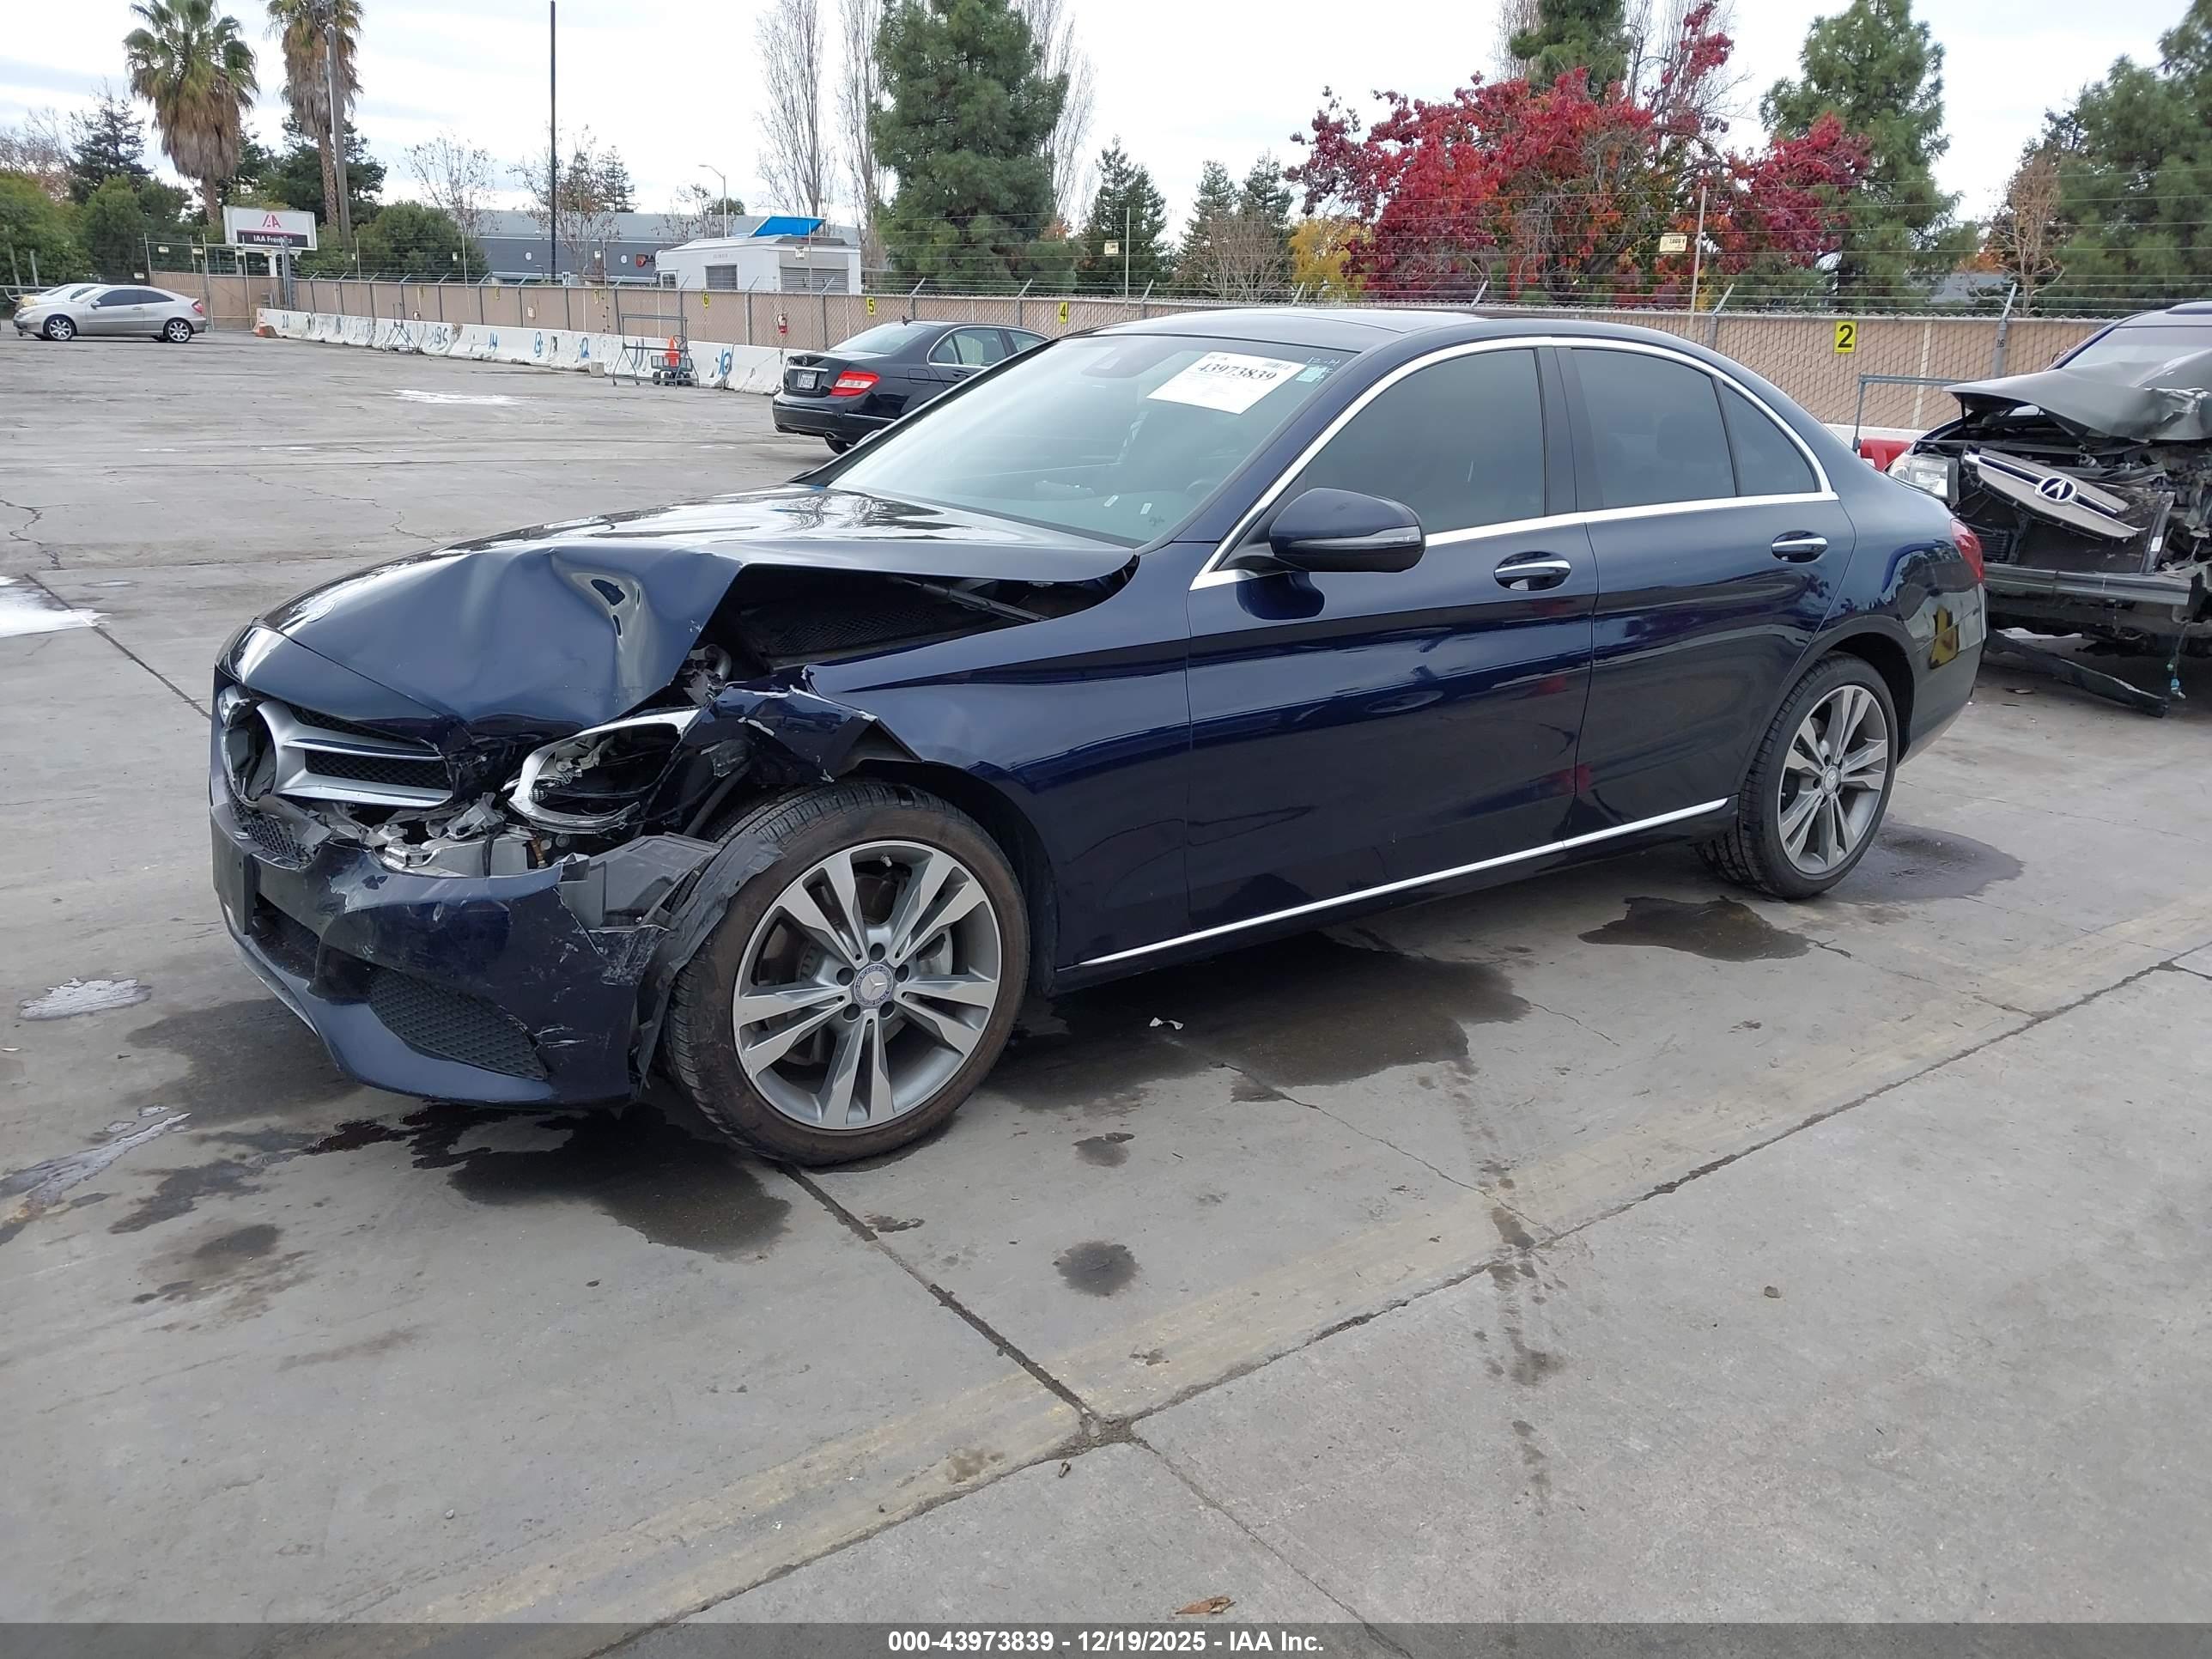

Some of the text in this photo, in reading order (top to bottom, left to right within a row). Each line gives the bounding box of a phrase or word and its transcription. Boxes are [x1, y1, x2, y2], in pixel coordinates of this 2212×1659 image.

[868, 299, 875, 313] 5
[1060, 303, 1066, 320] 4
[1838, 324, 1854, 349] 2
[1198, 362, 1278, 381] 43973839
